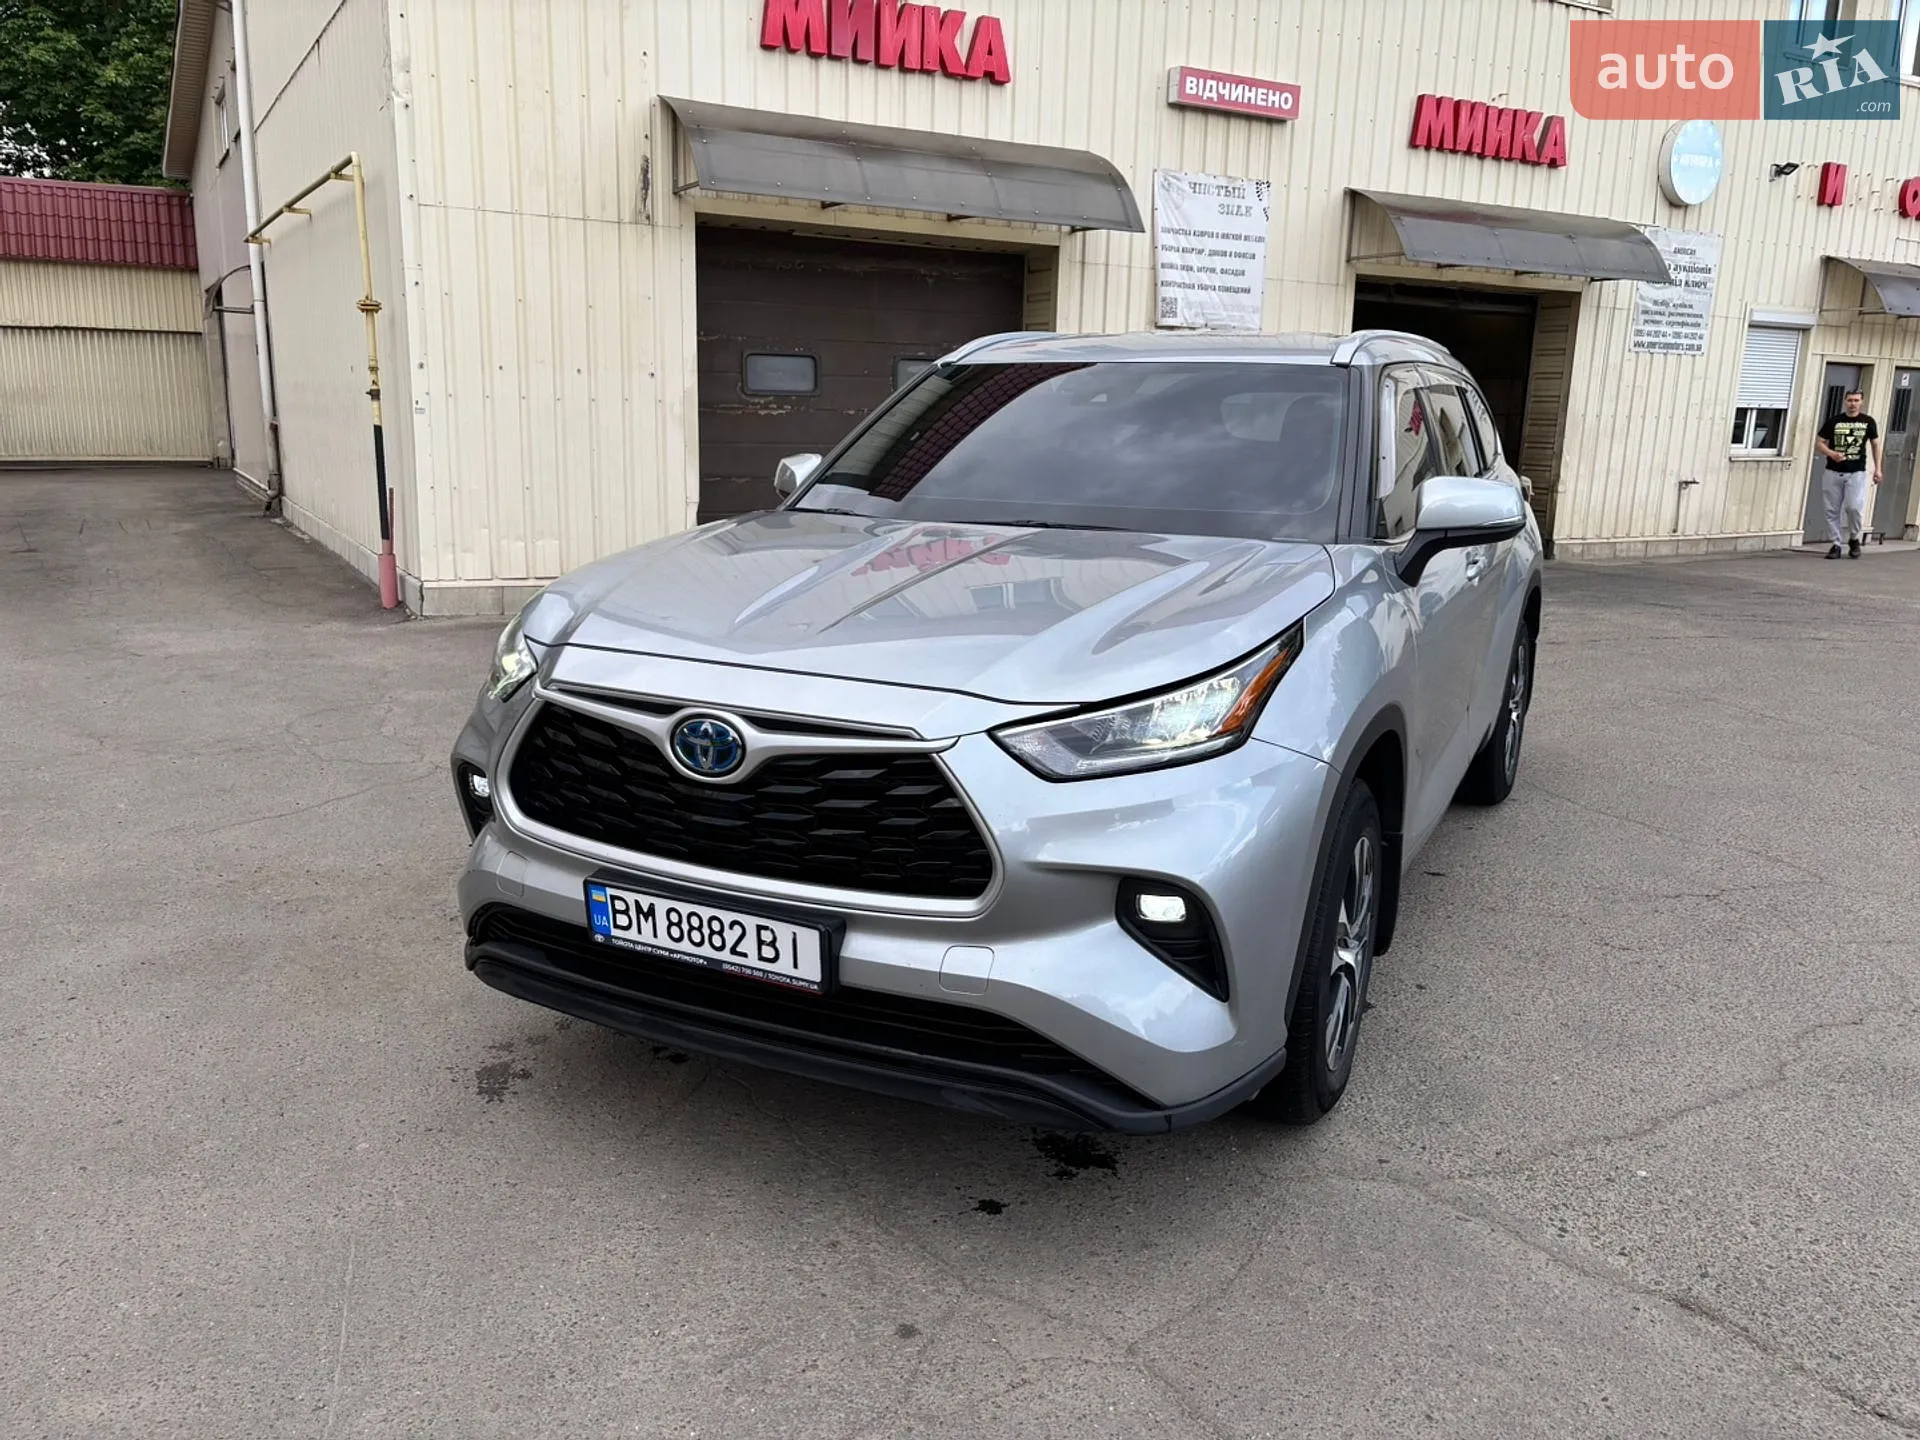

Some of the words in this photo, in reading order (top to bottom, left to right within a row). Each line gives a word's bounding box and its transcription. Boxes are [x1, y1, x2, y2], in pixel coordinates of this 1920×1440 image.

[1184, 76, 1294, 111] ВІДЧИНЕНО
[593, 916, 609, 928] UA
[609, 894, 658, 939] BM
[665, 907, 748, 959] 8882
[756, 924, 799, 970] BI
